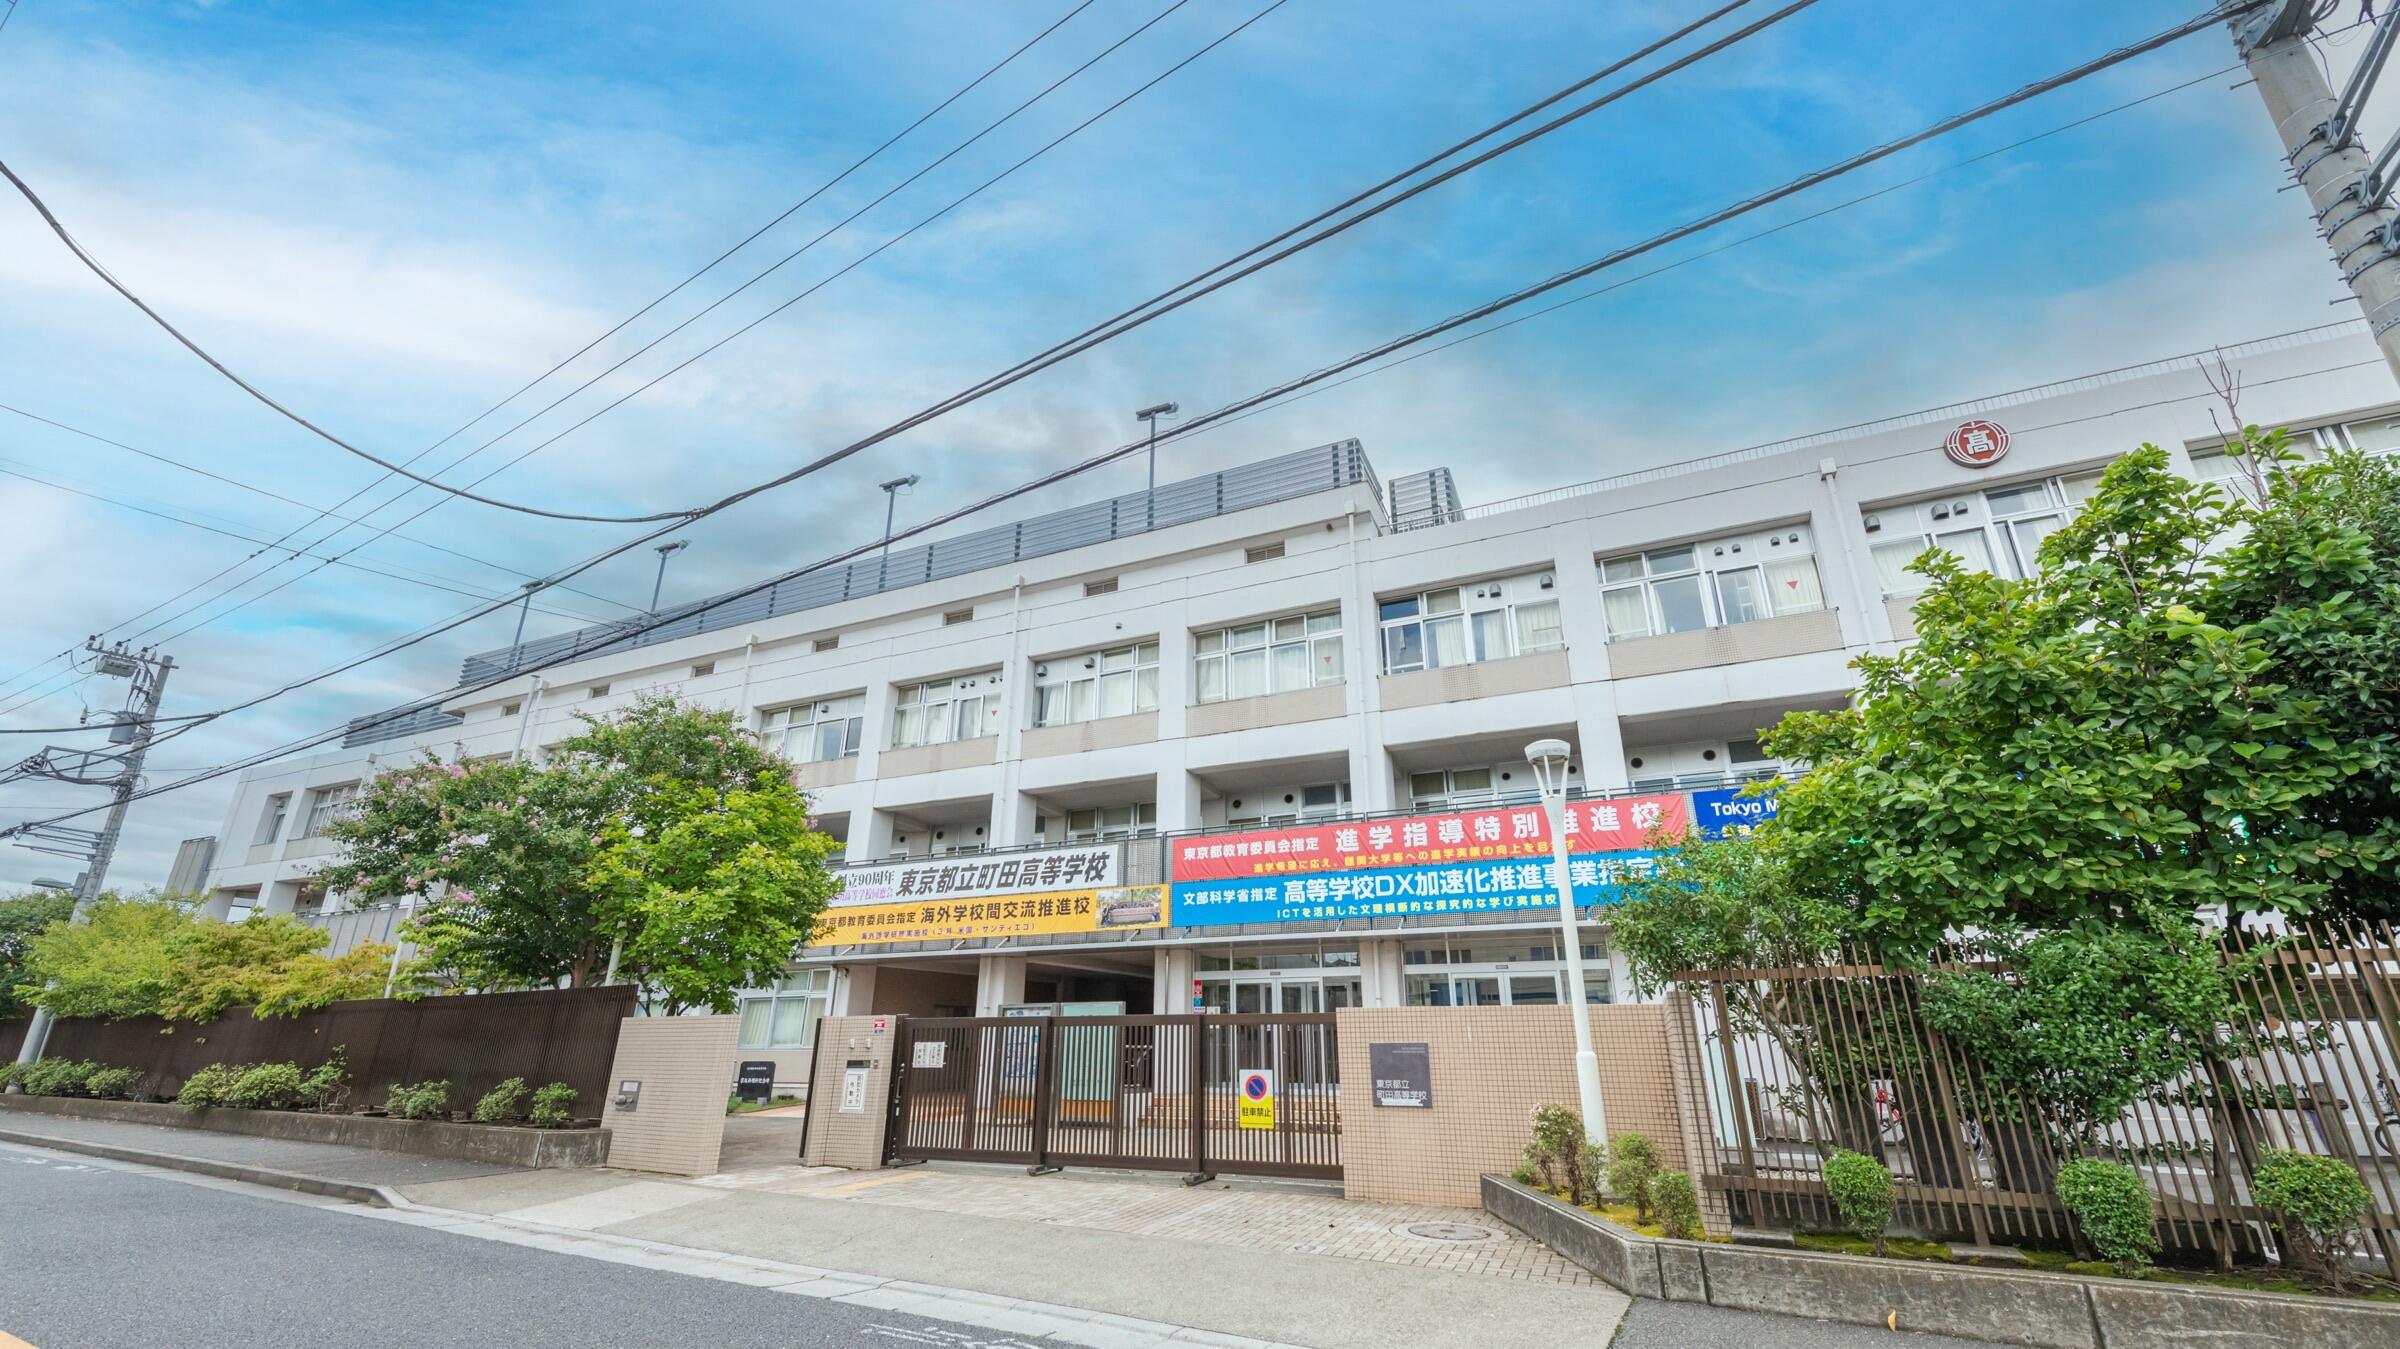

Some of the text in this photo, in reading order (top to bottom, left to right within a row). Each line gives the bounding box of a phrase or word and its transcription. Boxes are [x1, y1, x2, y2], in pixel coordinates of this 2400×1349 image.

[1710, 799, 1780, 816] Tokyo M
[1183, 837, 1320, 861] 東京都教育委員会指定
[1253, 840, 1576, 874] 進学希望に応え、難関大学等への進学実績の向上を目す
[841, 870, 896, 887] 立90周年
[895, 850, 1110, 897] 東京都立町田高等学校
[1183, 887, 1278, 906] 文部科学省指定
[819, 896, 1091, 929] 東京都教育委員会指定 海外学校間交流推進校
[1376, 1079, 1410, 1089] 東京都立
[1376, 1090, 1428, 1101] 町田高等学校
[1241, 1106, 1272, 1118] 駐車禁止
